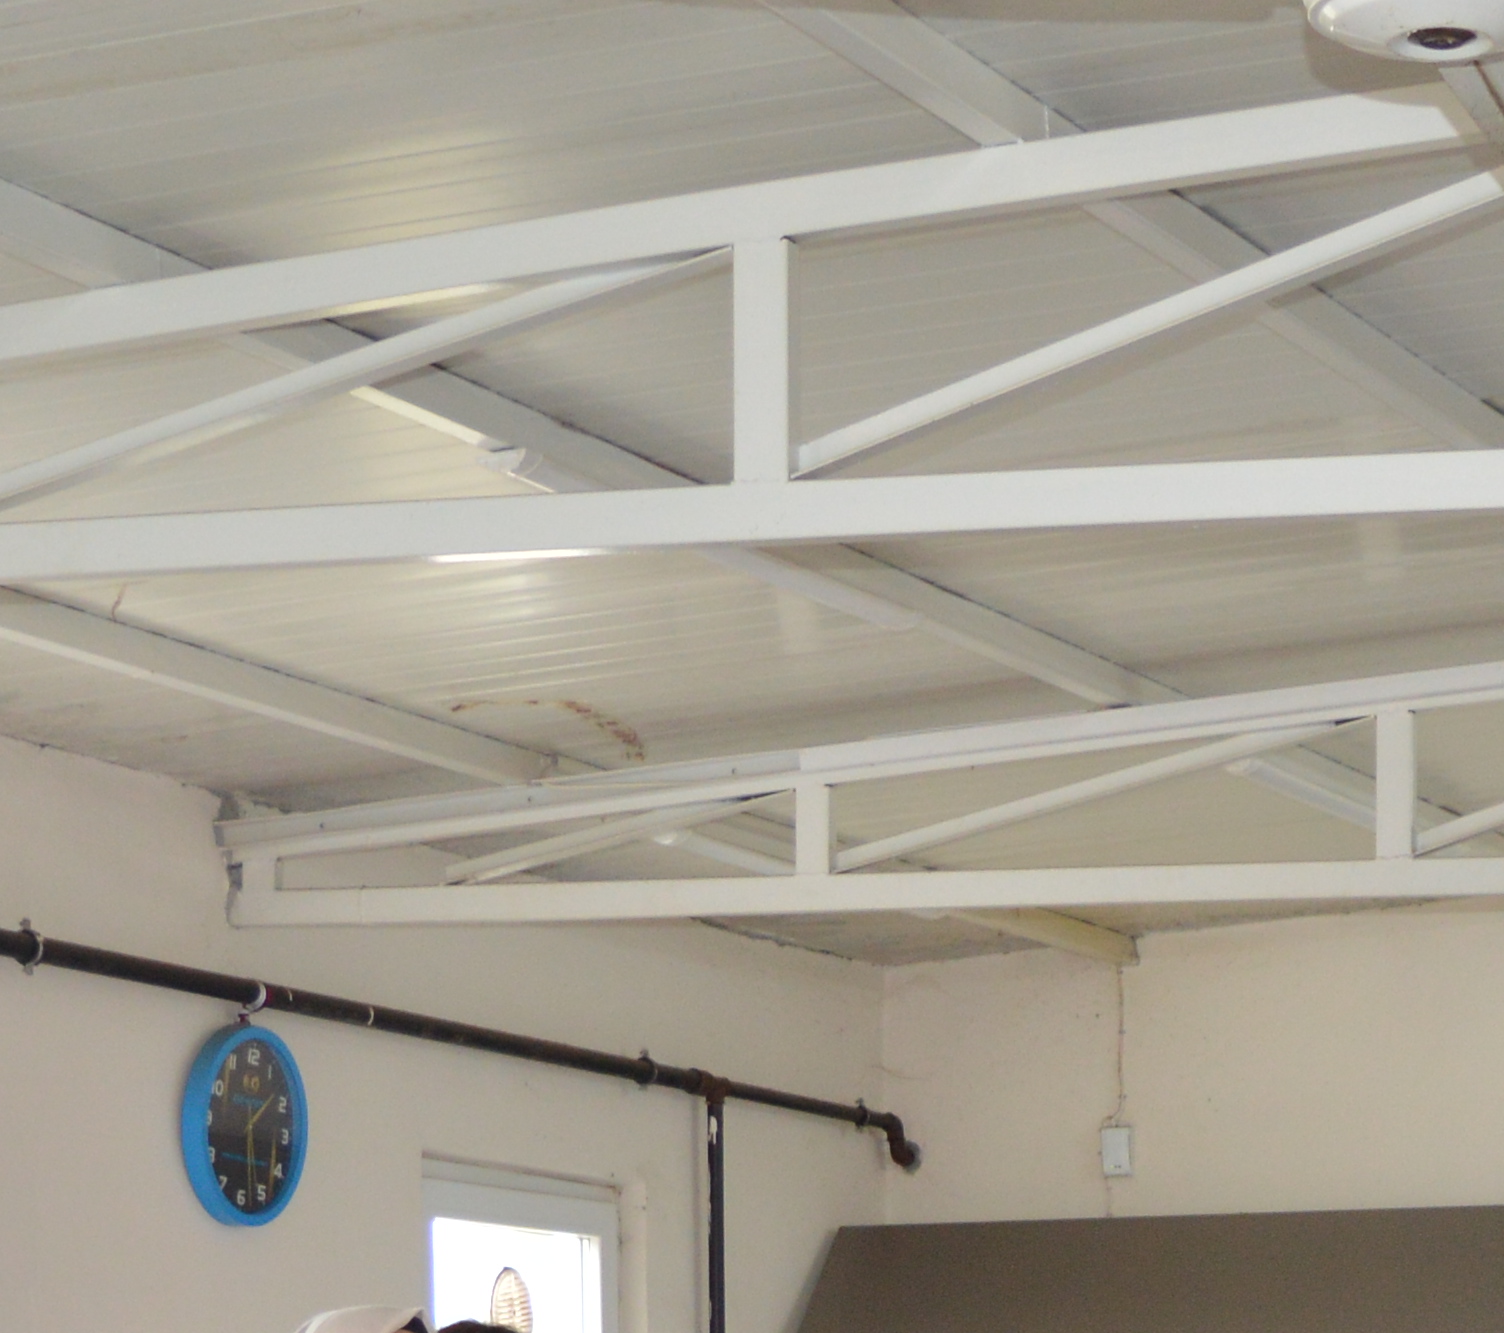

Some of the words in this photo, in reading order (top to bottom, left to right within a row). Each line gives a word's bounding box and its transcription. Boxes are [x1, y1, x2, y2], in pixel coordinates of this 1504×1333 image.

[247, 1047, 261, 1067] 12
[278, 1095, 287, 1114] 2
[281, 1127, 289, 1145] 3
[274, 1162, 284, 1179] 4
[236, 1189, 246, 1206] 6
[257, 1184, 266, 1201] 5
